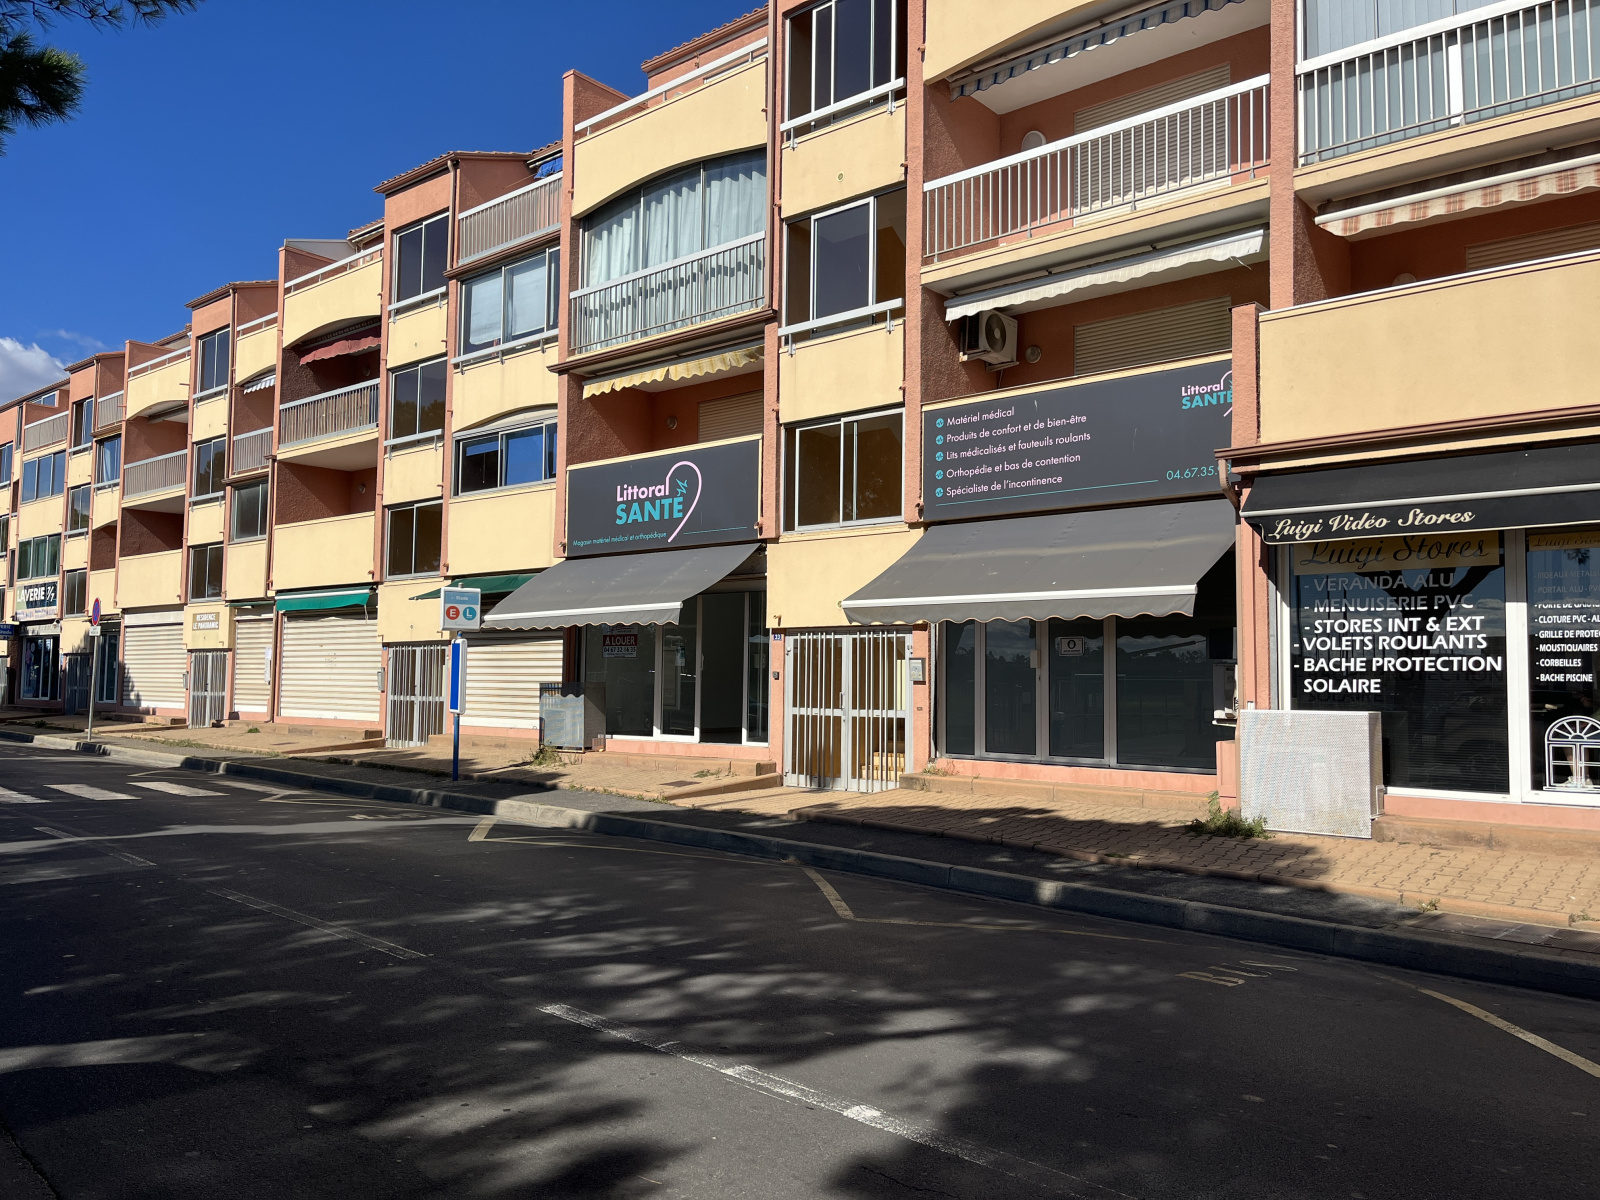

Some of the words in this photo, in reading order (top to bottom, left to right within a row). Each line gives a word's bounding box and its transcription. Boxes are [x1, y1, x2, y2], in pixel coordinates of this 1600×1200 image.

[1181, 380, 1224, 396] Littoral
[946, 411, 980, 427] Matériel
[981, 405, 1015, 421] médical
[946, 431, 977, 443] Produits
[979, 428, 990, 438] de
[991, 424, 1021, 436] confort
[1023, 422, 1032, 431] et
[1033, 419, 1045, 430] de
[1047, 414, 1087, 428] bien-être
[946, 451, 958, 460] Lits
[959, 443, 1007, 458] médicalisés
[1008, 442, 1017, 451] et
[1018, 435, 1054, 450] fauteuils
[1055, 432, 1091, 445] roulants
[946, 464, 992, 478] Orthopédie
[994, 463, 1003, 472] et
[1004, 461, 1020, 471] bas
[1021, 458, 1033, 469] de
[1034, 453, 1081, 467] contention
[616, 478, 670, 502] Littoral
[946, 483, 989, 498] Spécialiste
[990, 481, 1002, 491] de
[1268, 518, 1324, 541] Luigi
[1328, 513, 1390, 532] Vidéo
[1397, 508, 1475, 526] Stores
[572, 539, 592, 548] Magasin
[592, 535, 611, 545] matériel
[611, 534, 629, 543] médical
[635, 531, 667, 541] orthopédique
[1300, 540, 1386, 569] Luigi
[1393, 535, 1490, 562] Stores
[1313, 575, 1408, 592] VERANDA
[1413, 572, 1455, 588] ALU
[1537, 586, 1567, 594] PORTAIL
[1569, 585, 1583, 593] ALU
[16, 586, 45, 602] LAVERIE
[1313, 595, 1428, 613] MENUISERIE
[1434, 593, 1474, 609] PVC
[450, 608, 456, 617] E
[466, 608, 472, 617] L
[1538, 615, 1571, 624] CLOTURE
[1572, 615, 1587, 623] PVC
[193, 622, 198, 630] LE
[1313, 618, 1383, 634] STORES
[1388, 617, 1421, 632] INT
[1425, 617, 1440, 632] &
[1446, 616, 1485, 631] EXT
[605, 636, 611, 645] A
[612, 636, 635, 645] LOUER
[1303, 635, 1373, 651] VOLETS
[1379, 634, 1487, 650] ROULANTS
[1539, 630, 1563, 639] GRILLE
[1564, 630, 1575, 638] DE
[1539, 644, 1598, 652] MOUSTIQUAIRES
[1303, 657, 1367, 672] BACHE
[1372, 656, 1502, 671] PROTECTION
[1539, 658, 1582, 667] CORBEILLES
[1303, 678, 1381, 693] SOLAIRE
[1540, 674, 1565, 682] BACHE
[1565, 673, 1593, 681] PISCINE
